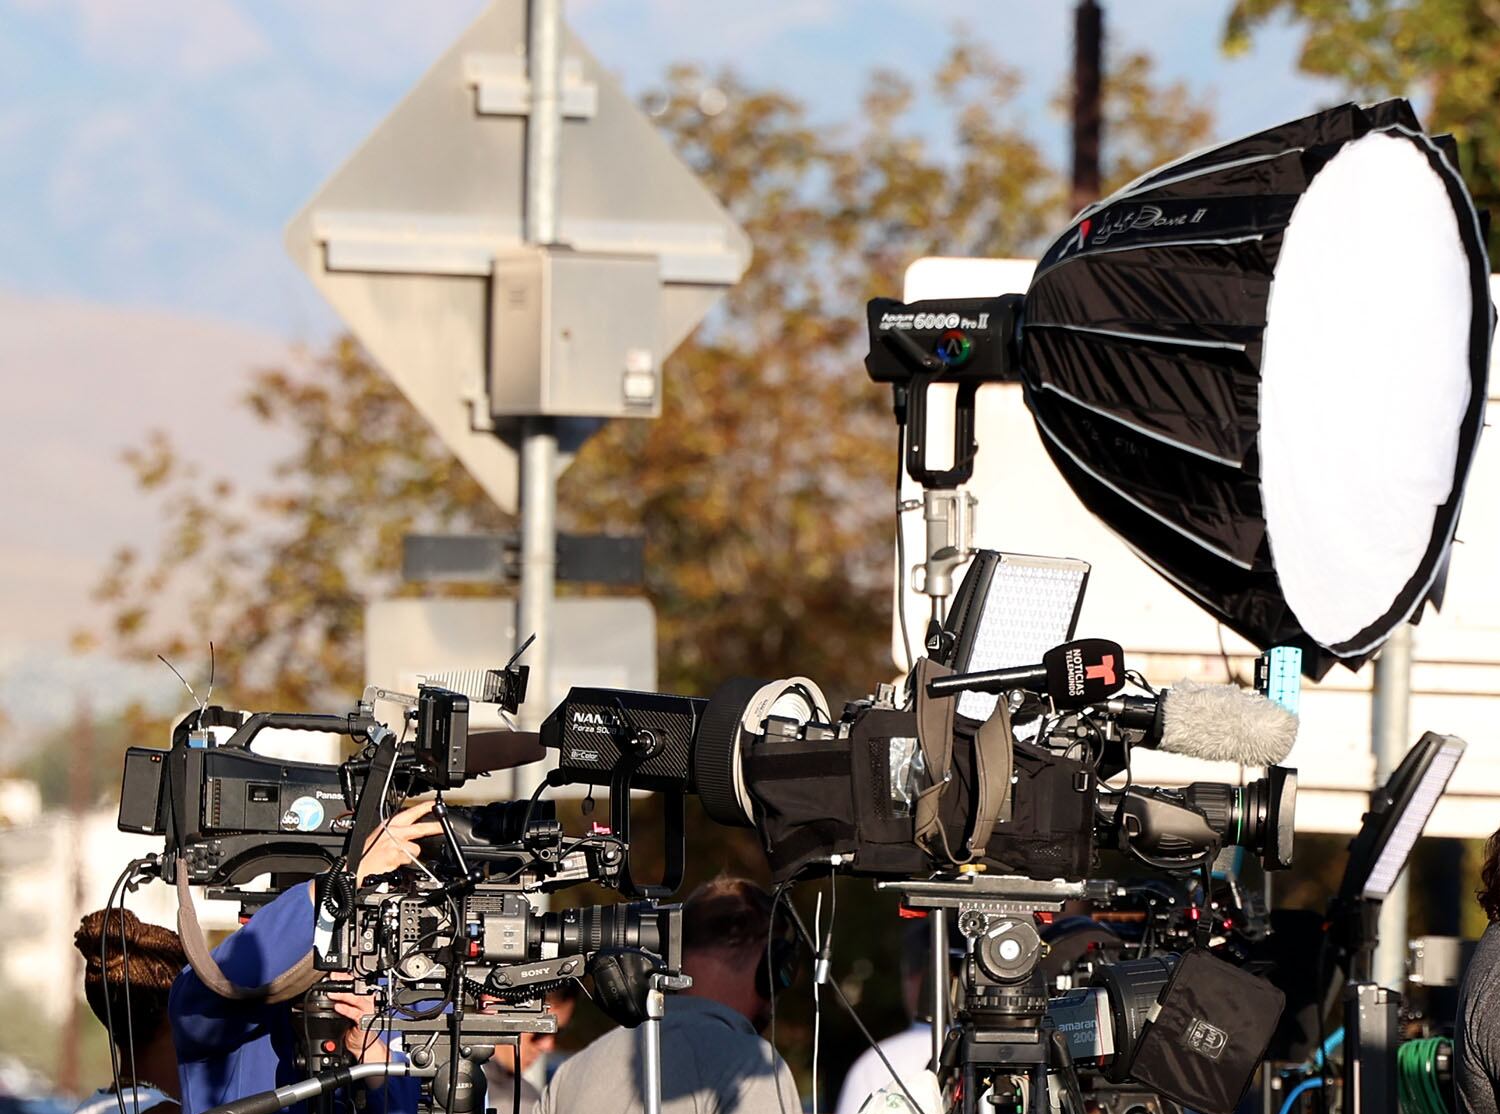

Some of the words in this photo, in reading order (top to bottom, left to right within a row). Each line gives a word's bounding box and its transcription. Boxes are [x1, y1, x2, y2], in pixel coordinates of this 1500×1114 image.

[960, 319, 977, 329] Pro
[1065, 650, 1076, 696] TELEMUNDO
[1072, 648, 1085, 696] NOTICIAS
[572, 723, 595, 733] Forza
[520, 967, 550, 978] SONY
